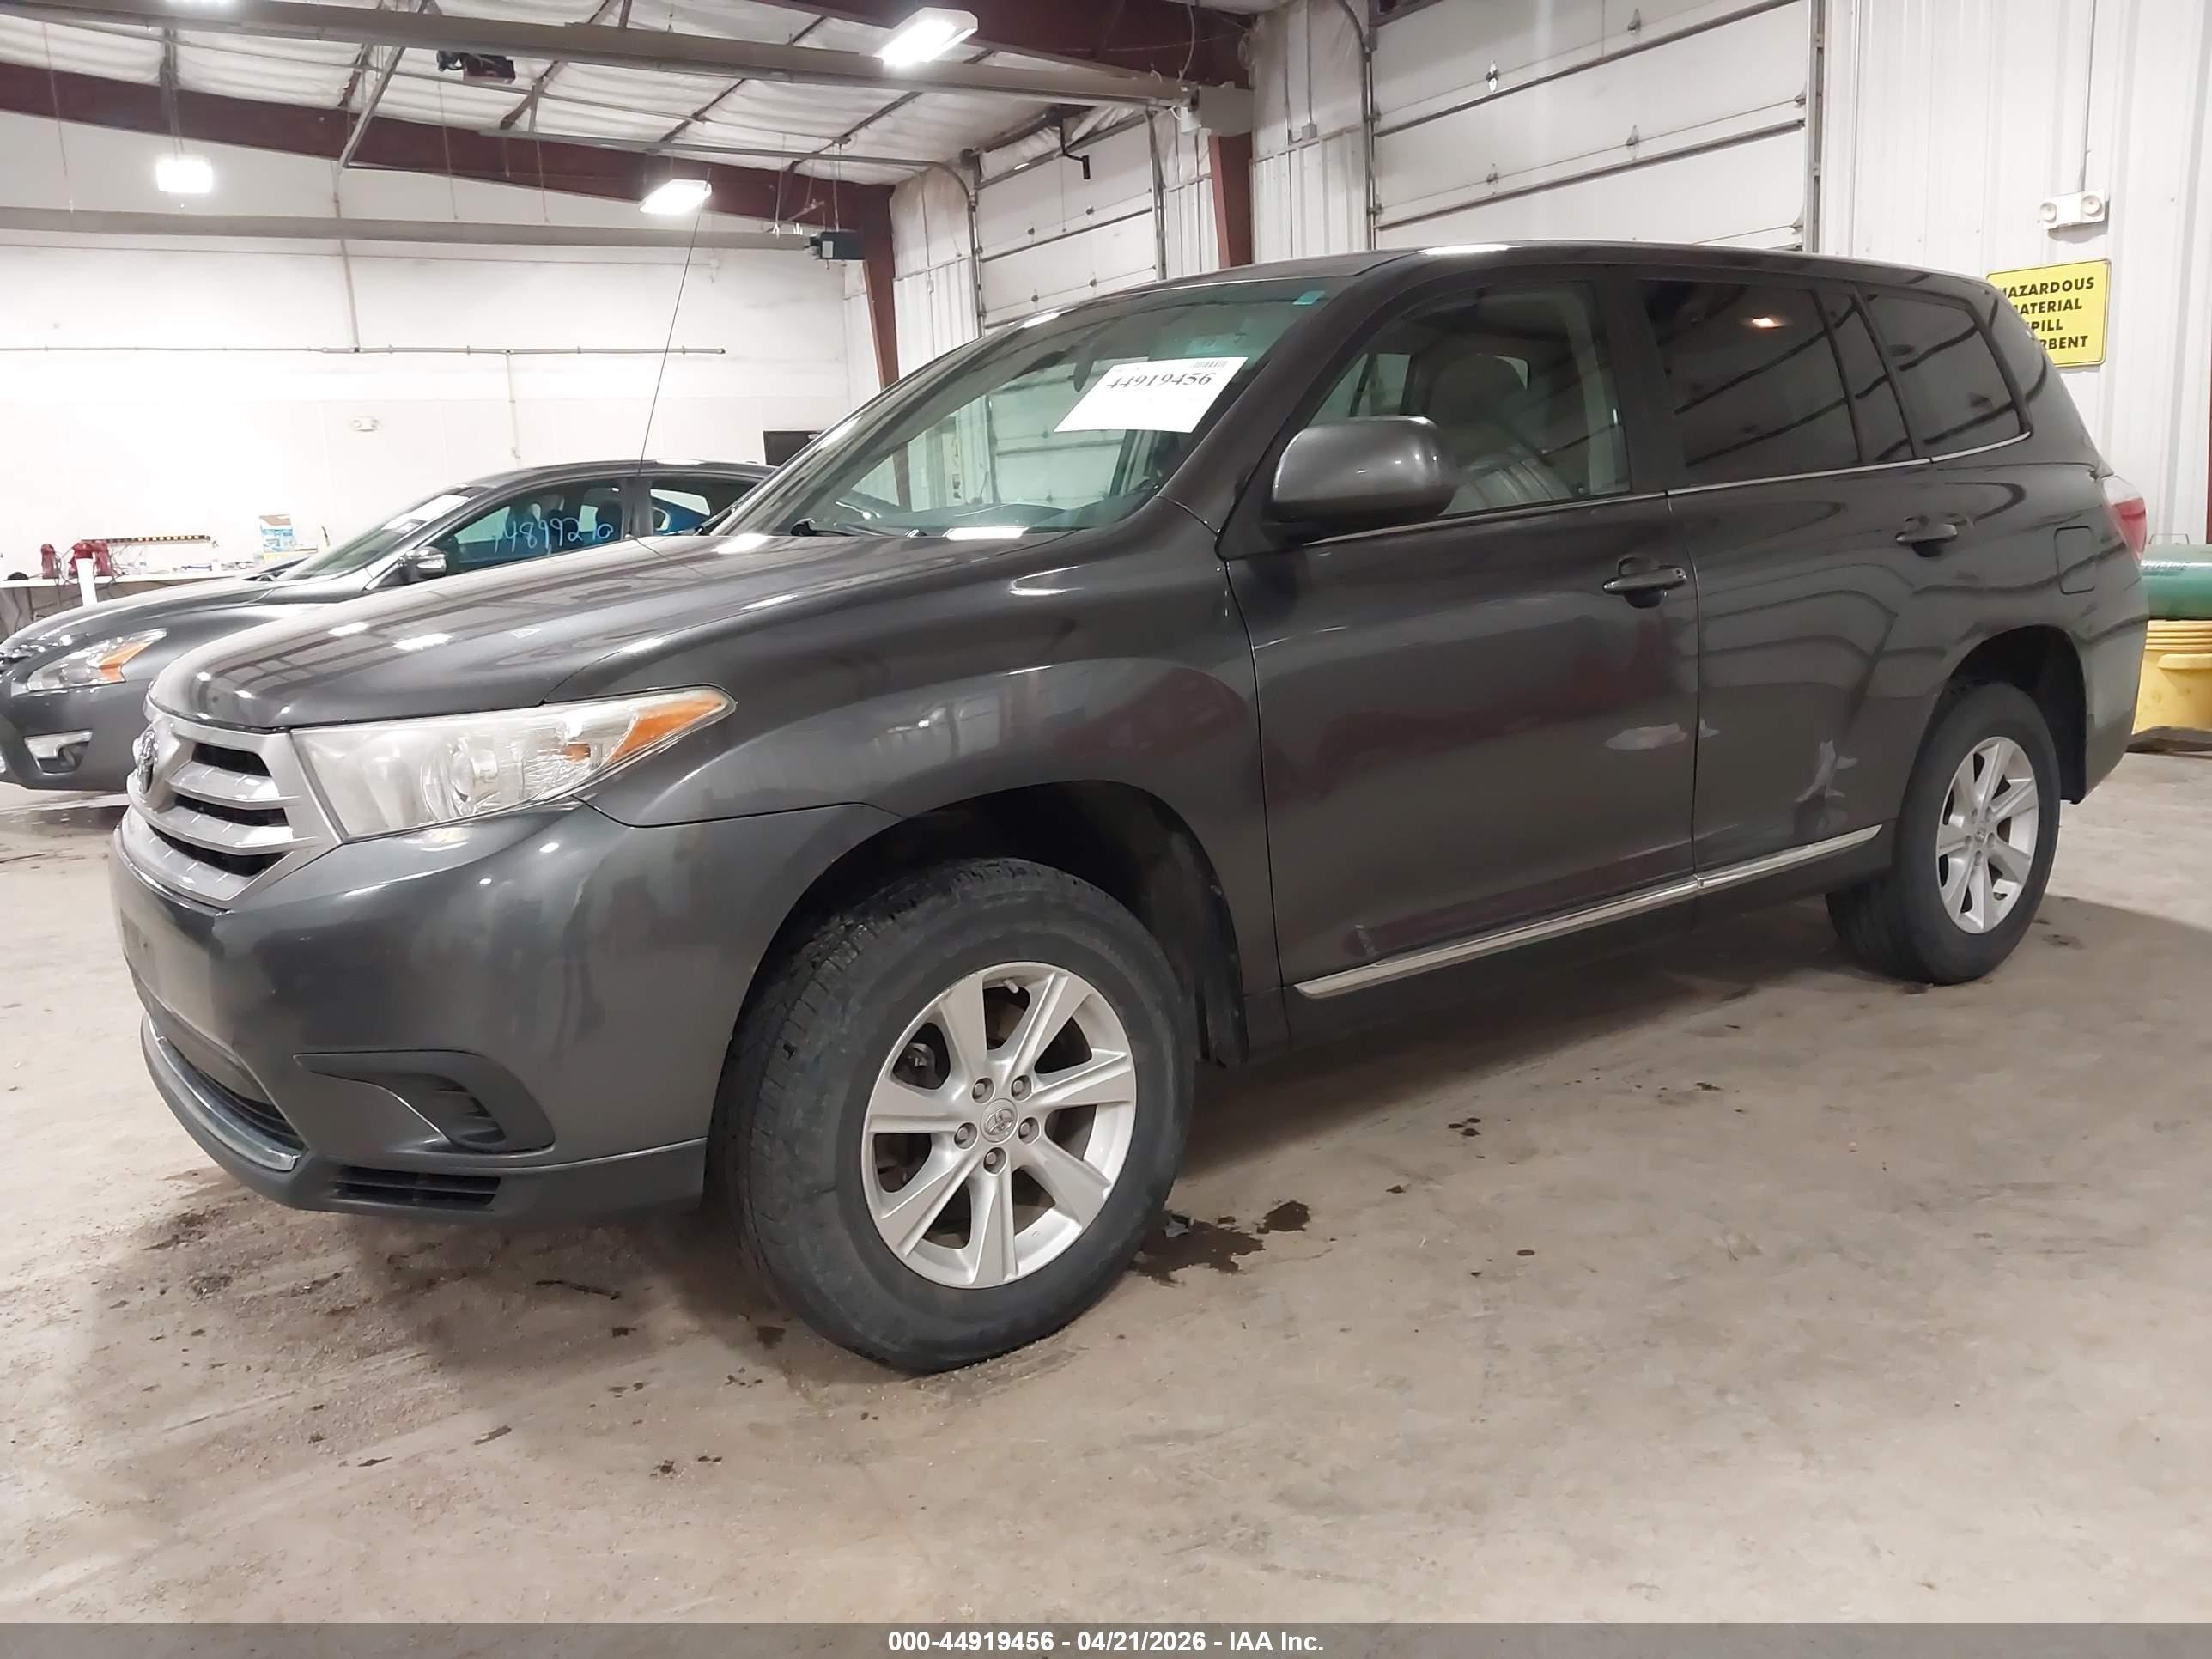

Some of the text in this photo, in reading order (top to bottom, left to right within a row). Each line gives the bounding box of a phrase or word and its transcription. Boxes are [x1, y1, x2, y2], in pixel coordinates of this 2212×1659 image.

[2014, 298, 2082, 315] ATERIAL
[2027, 319, 2063, 332] PILL
[1107, 373, 1216, 388] 44919456
